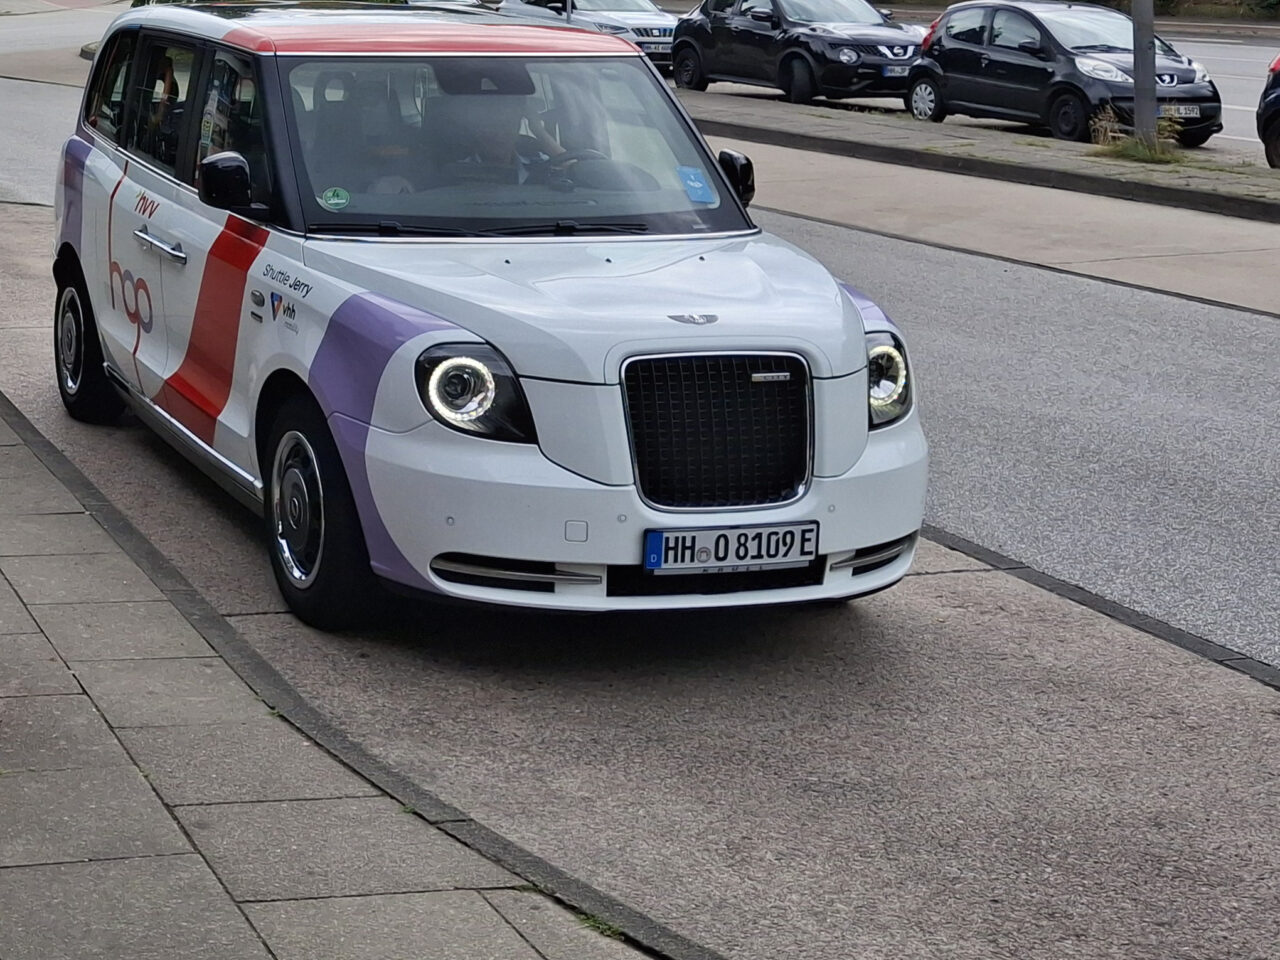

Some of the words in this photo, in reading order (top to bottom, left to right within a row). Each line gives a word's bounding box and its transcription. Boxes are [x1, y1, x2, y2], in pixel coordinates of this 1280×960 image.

[134, 191, 161, 219] hvv
[262, 263, 291, 286] Shuttle
[288, 277, 314, 299] Jerry
[663, 535, 697, 564] HH
